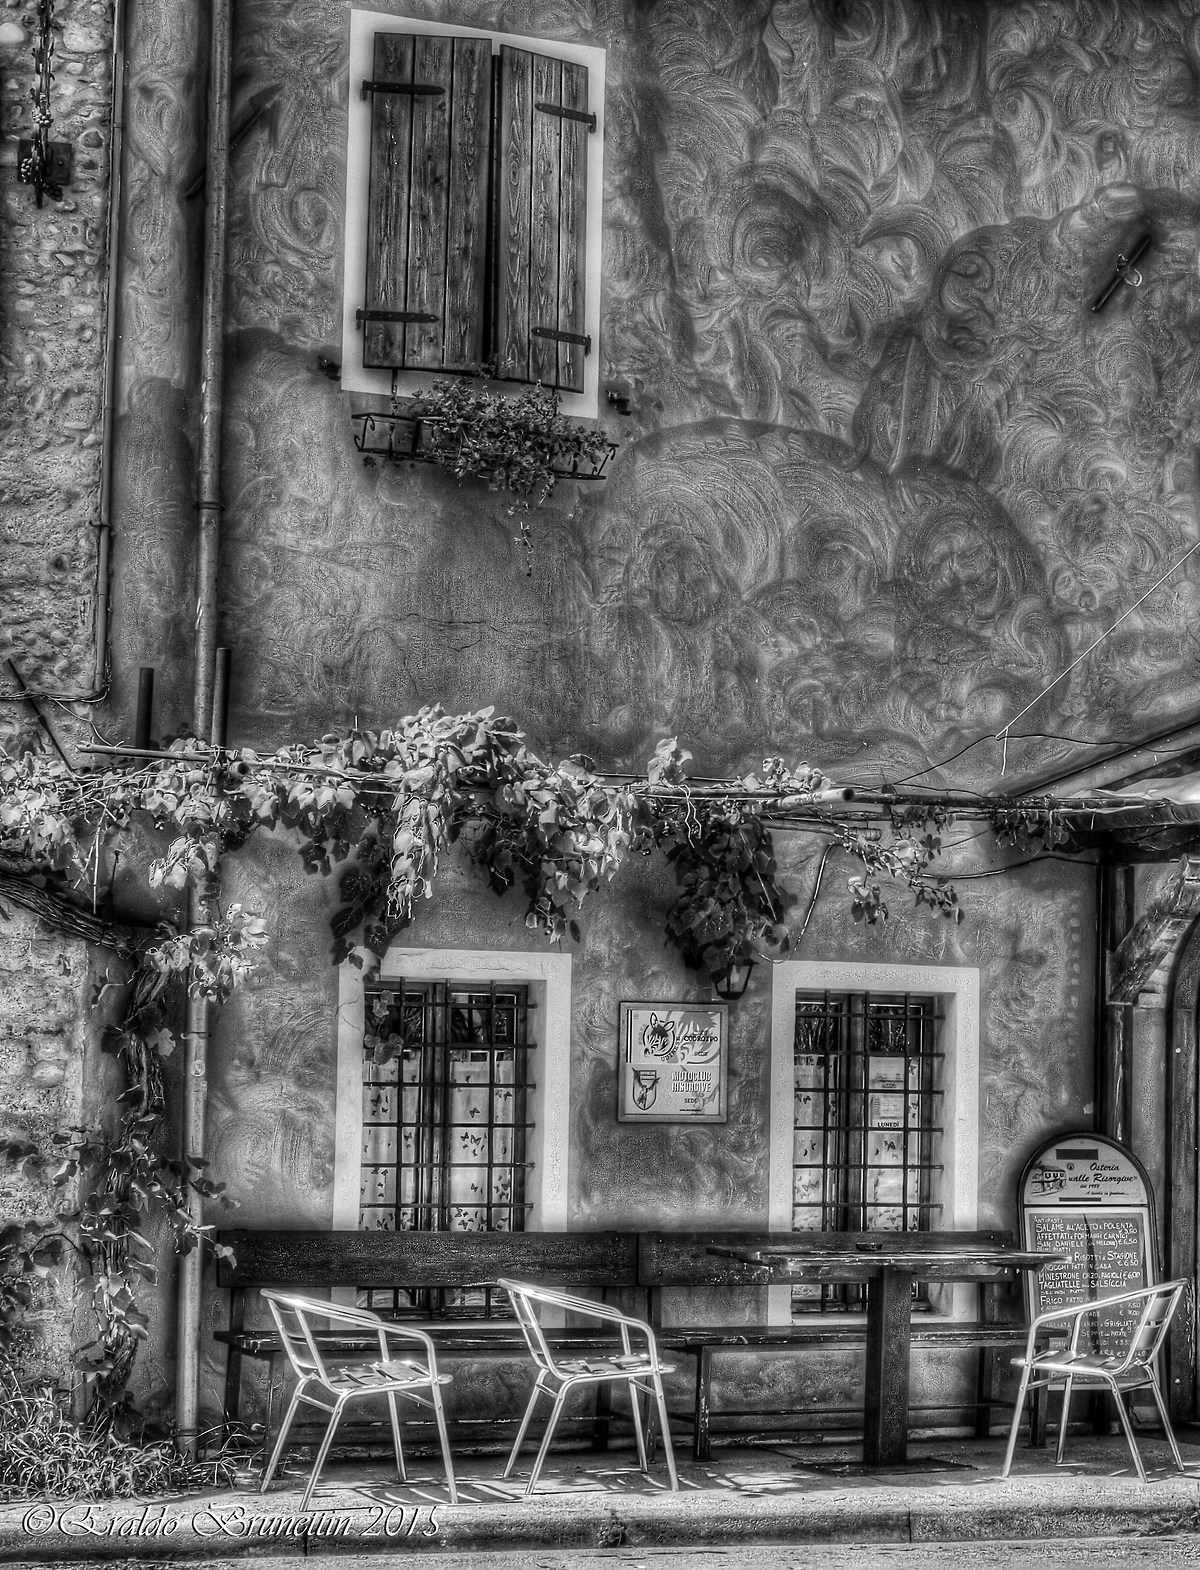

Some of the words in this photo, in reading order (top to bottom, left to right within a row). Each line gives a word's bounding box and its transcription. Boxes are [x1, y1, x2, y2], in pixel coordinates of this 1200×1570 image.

[1089, 1162, 1120, 1171] Osteria
[1035, 1223, 1064, 1233] SALAME
[1103, 1222, 1134, 1230] POLENTA
[1036, 1232, 1070, 1241] AFFETTATI
[1055, 1240, 1084, 1248] DANIELE
[1107, 1250, 1137, 1261] STAGIONE
[1038, 1271, 1080, 1281] MINESTRONE
[1039, 1280, 1080, 1290] TAGLIATELLE
[1090, 1279, 1127, 1288] SALSICCIA
[1040, 1295, 1063, 1305] FRICO
